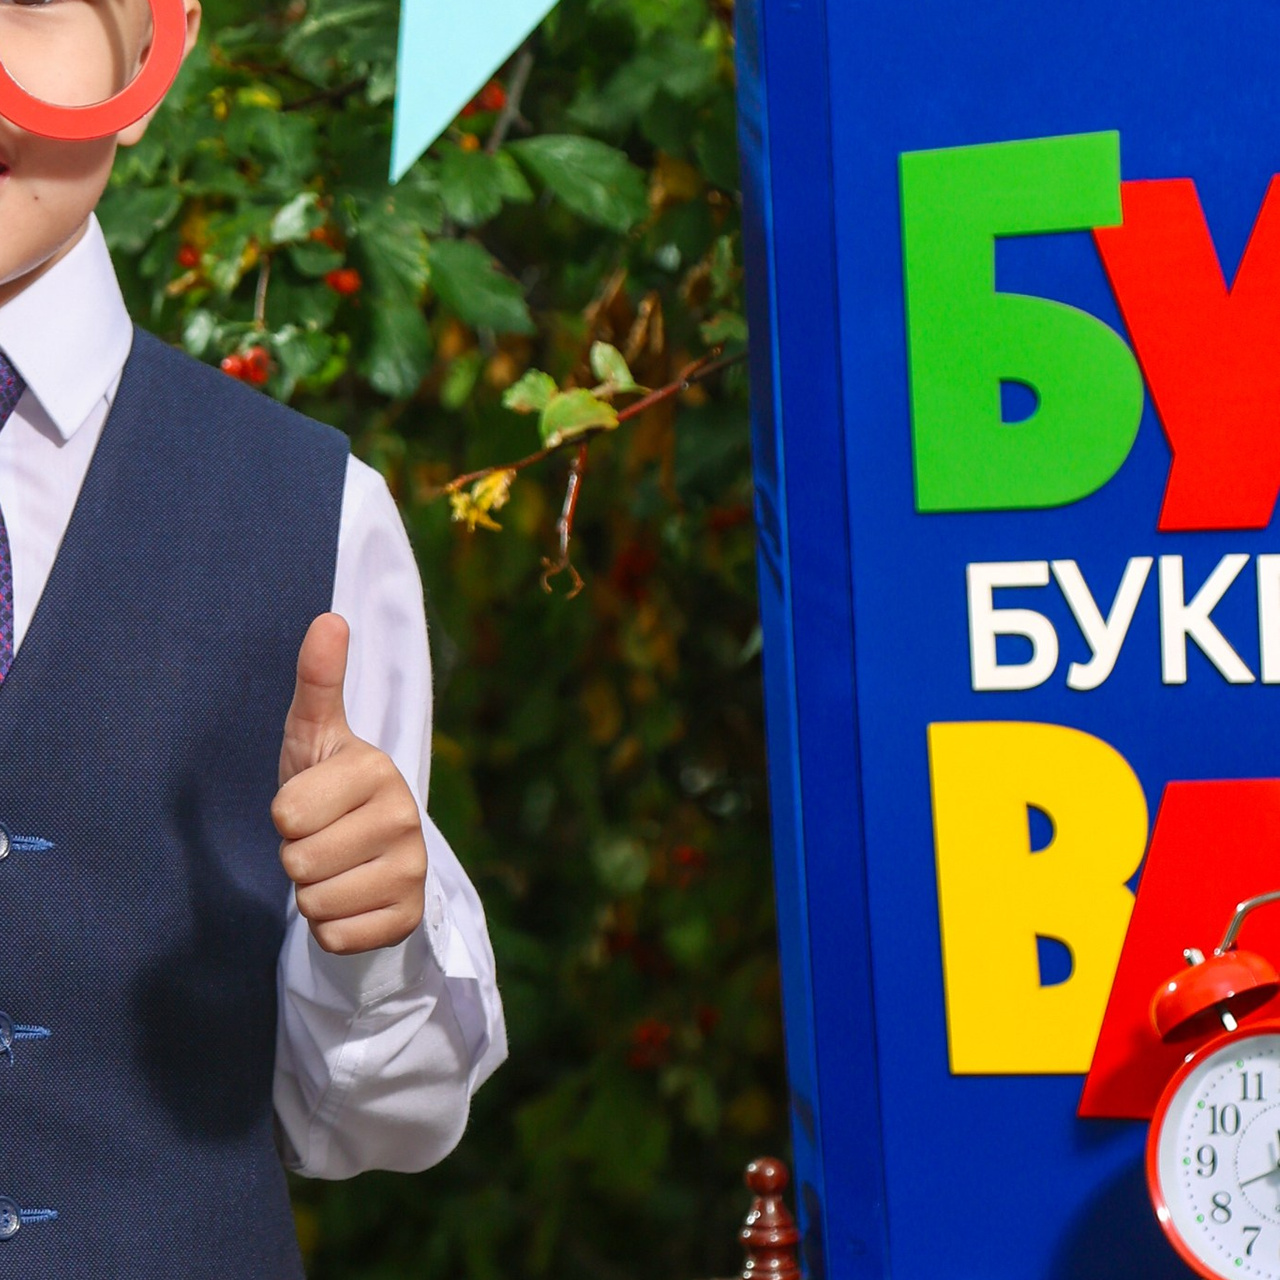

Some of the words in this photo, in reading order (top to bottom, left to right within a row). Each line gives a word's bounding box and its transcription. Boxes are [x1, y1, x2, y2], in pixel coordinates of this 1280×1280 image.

[966, 553, 1280, 691] БУК
[1239, 1072, 1267, 1102] 11
[1208, 1103, 1242, 1136] 10
[1196, 1143, 1218, 1178] 9
[1210, 1190, 1232, 1225] 8
[1242, 1225, 1262, 1257] 7
